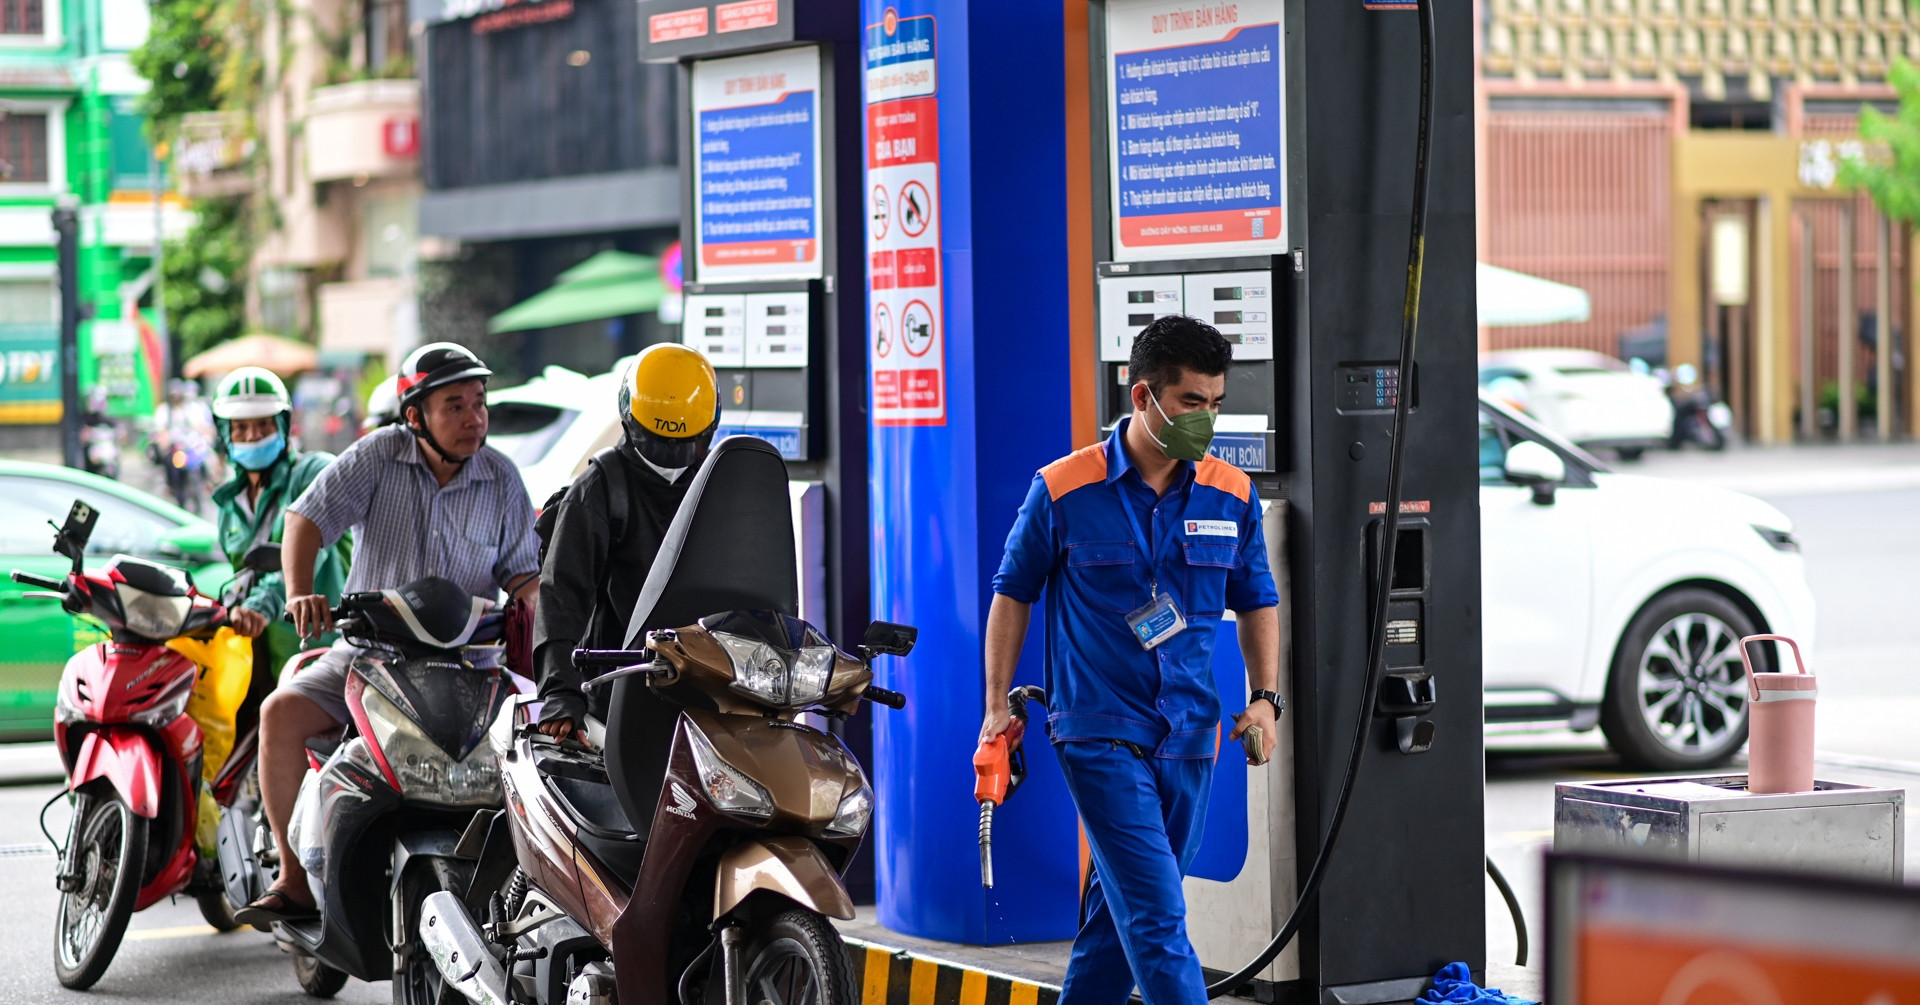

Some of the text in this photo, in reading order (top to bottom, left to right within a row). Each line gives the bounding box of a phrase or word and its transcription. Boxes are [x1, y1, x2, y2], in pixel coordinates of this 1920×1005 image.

[1152, 2, 1238, 34] QUY TRÌNH BÁN HÀNG
[893, 137, 916, 162] BẠN
[1220, 446, 1236, 464] KHI
[1238, 444, 1262, 466] BƠM
[666, 805, 698, 821] HONDA
